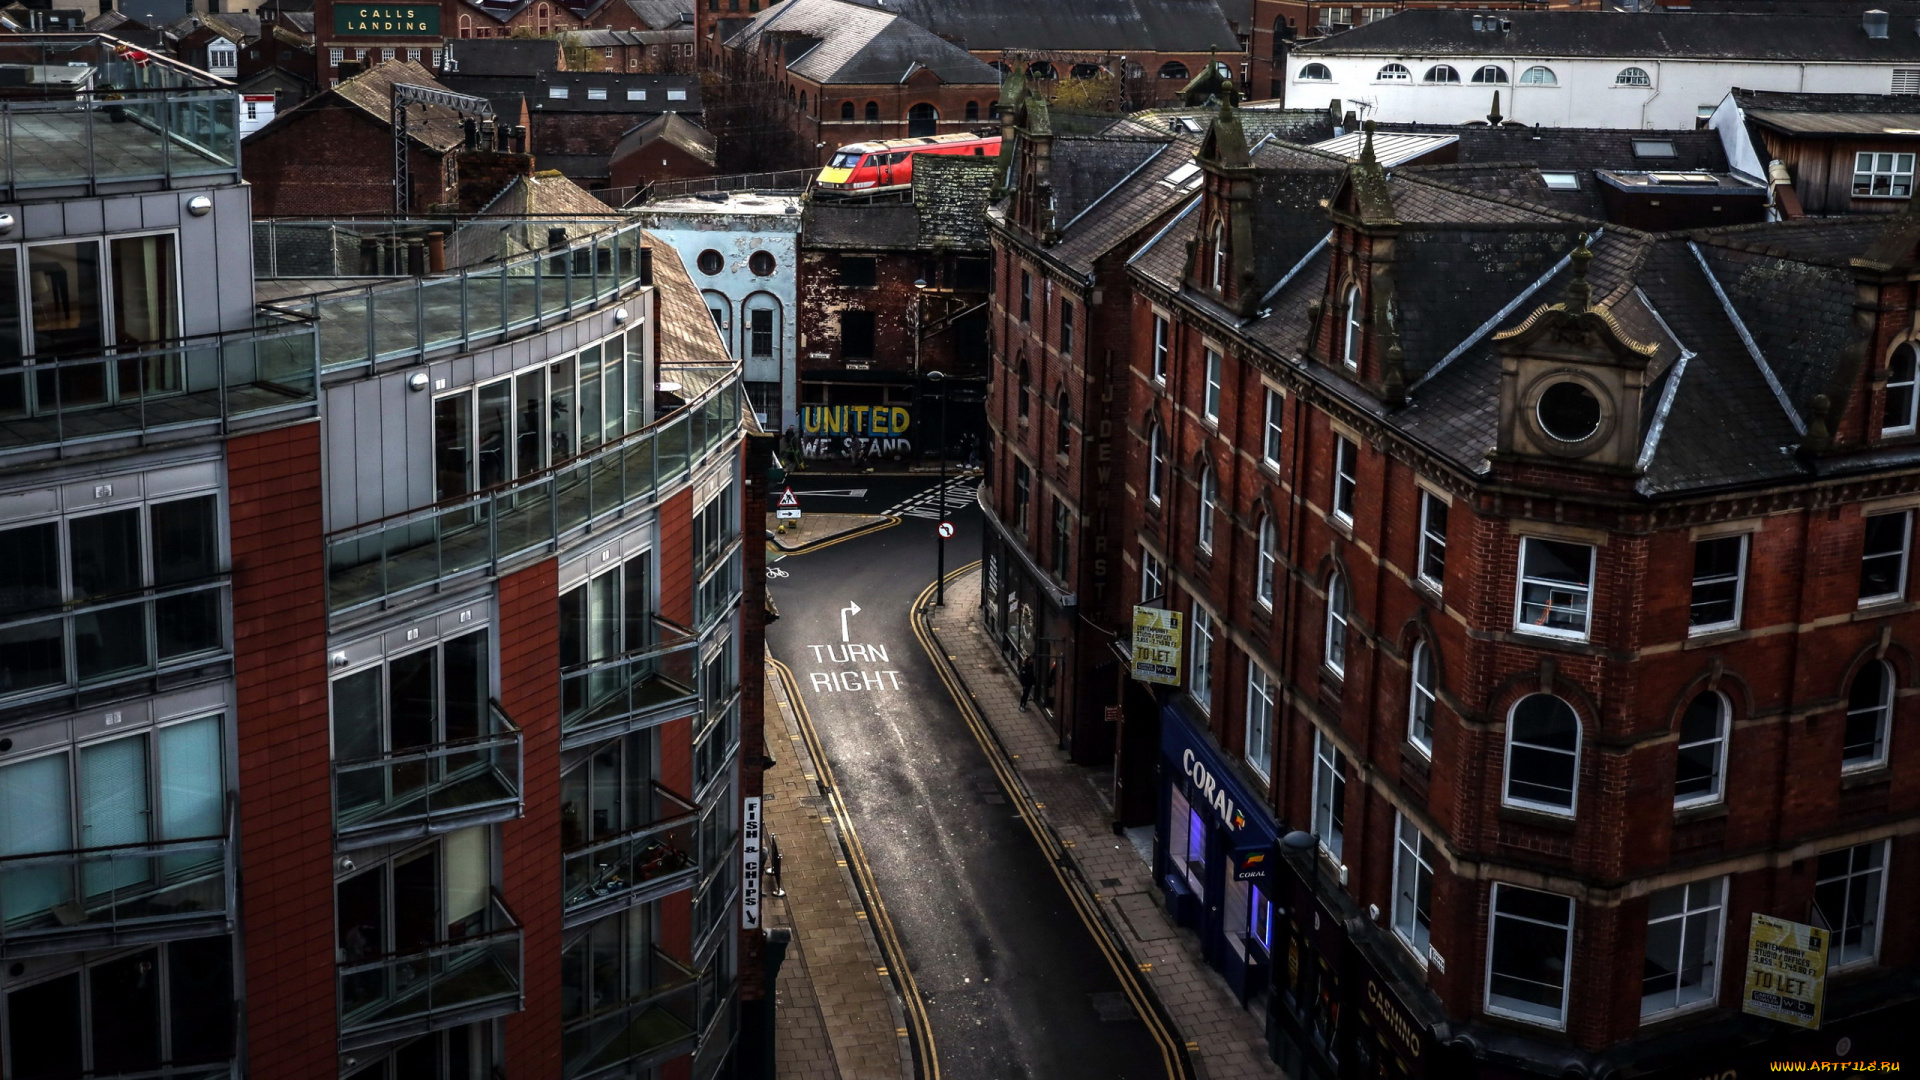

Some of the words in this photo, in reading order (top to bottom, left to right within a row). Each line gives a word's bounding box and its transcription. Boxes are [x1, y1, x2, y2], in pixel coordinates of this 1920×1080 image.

[360, 9, 414, 18] CALLS
[348, 22, 427, 31] LANDING
[801, 404, 911, 437] UNITED
[800, 438, 832, 458] WE
[841, 438, 912, 459] STAND
[807, 644, 889, 663] TURN
[1136, 646, 1149, 660] TO
[1152, 648, 1170, 663] LET
[810, 670, 899, 693] RIGHT
[1183, 748, 1235, 831] CORAL
[745, 803, 758, 839] FISH
[744, 862, 758, 906] CHIPS
[1239, 870, 1266, 879] CORAL
[1754, 947, 1777, 960] STUDIO
[1784, 955, 1810, 968] OFFICES
[1755, 940, 1805, 957] CONTEMPORARY
[1754, 970, 1772, 988] TO
[1777, 974, 1805, 996] LET
[1808, 969, 1817, 977] FT
[1367, 979, 1420, 1058] CASHINO
